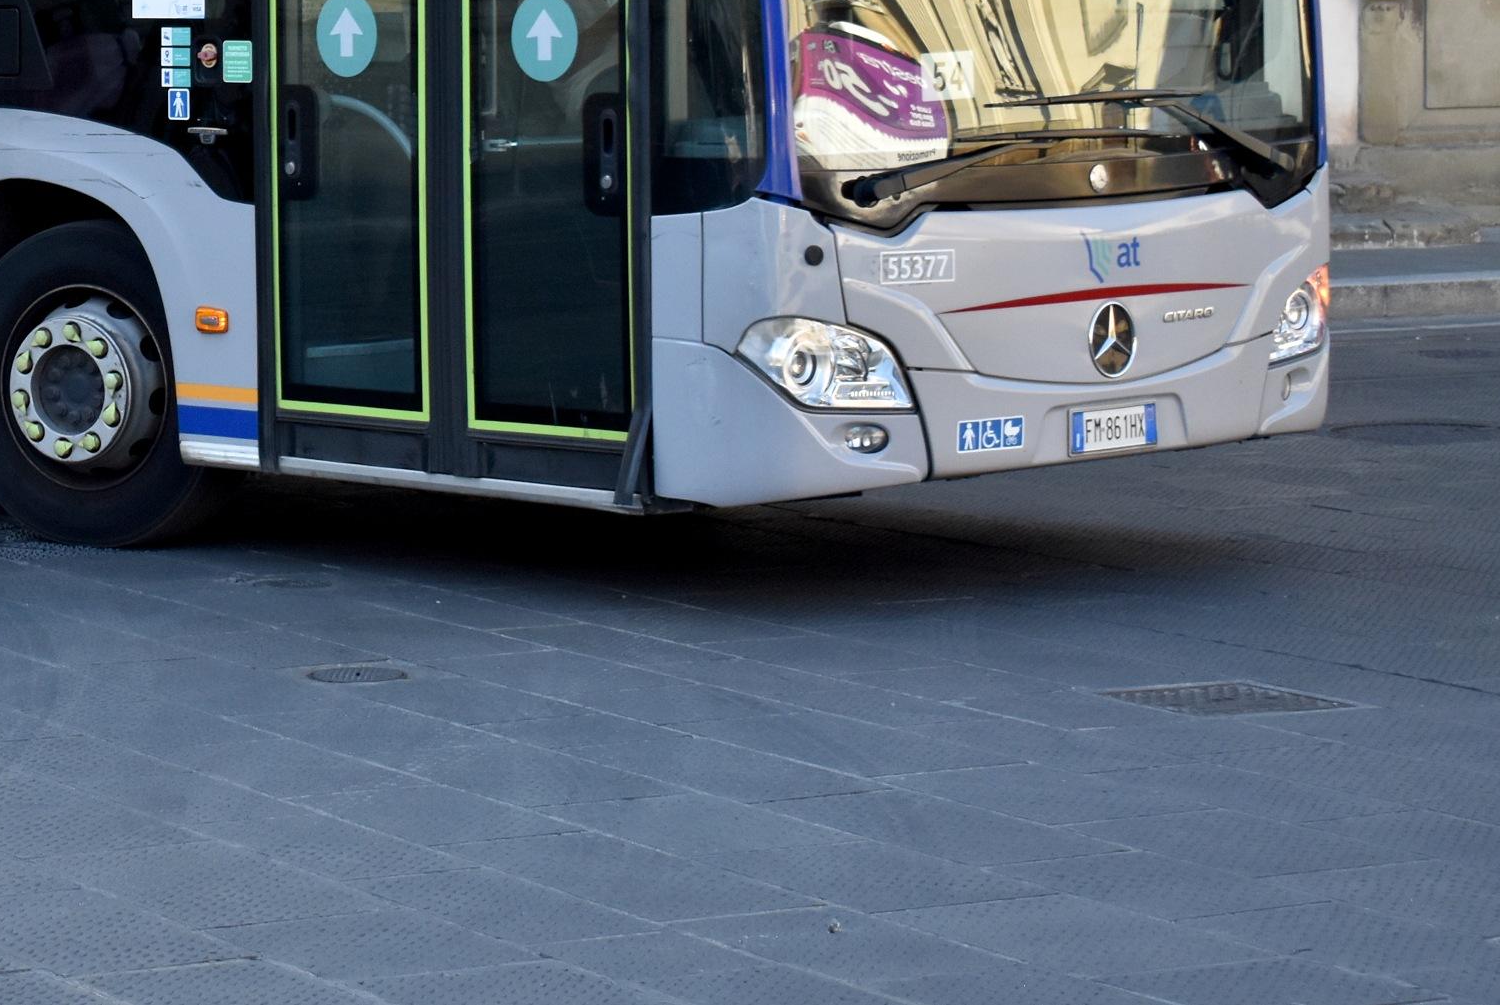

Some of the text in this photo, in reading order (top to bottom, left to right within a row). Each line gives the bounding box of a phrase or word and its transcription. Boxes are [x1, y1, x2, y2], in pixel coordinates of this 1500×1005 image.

[933, 61, 964, 92] 54
[1117, 237, 1140, 267] at
[888, 254, 948, 279] 55377
[1162, 307, 1214, 322] CITARO
